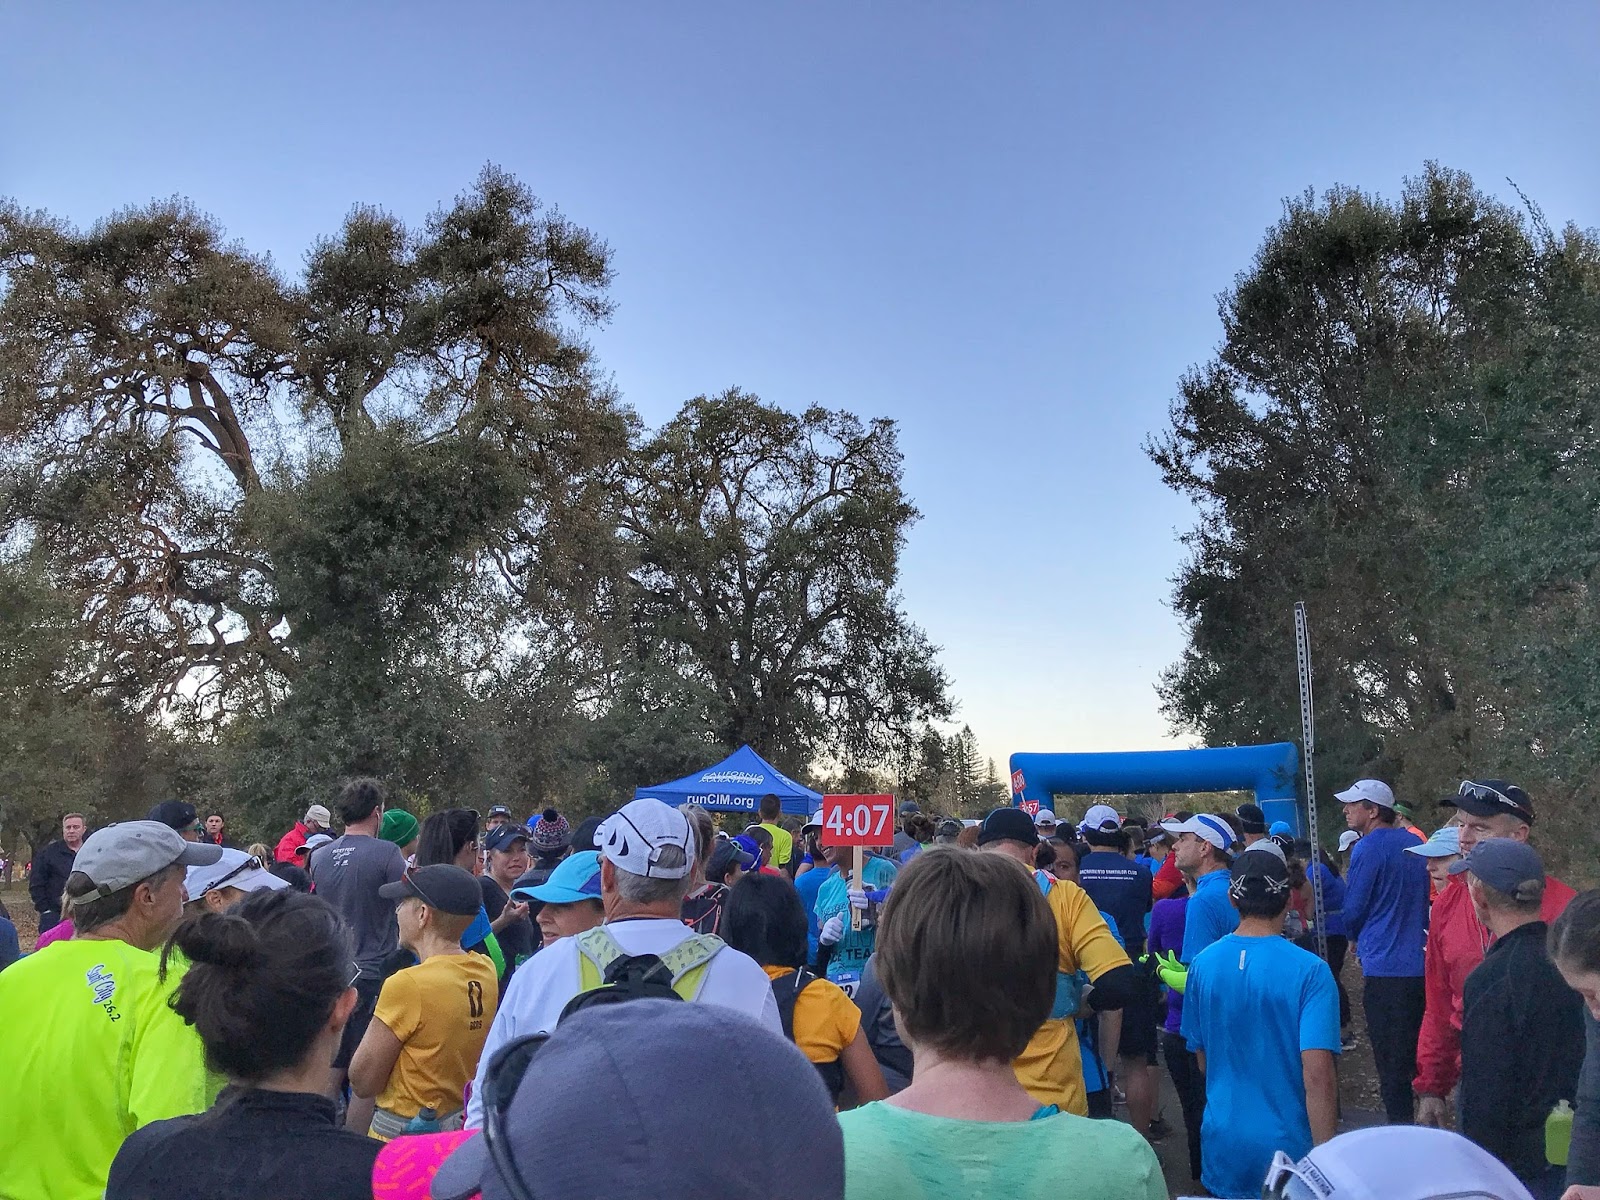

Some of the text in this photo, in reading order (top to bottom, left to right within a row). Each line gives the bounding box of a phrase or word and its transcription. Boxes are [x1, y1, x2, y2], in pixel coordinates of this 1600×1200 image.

[687, 793, 754, 809] runCIM.org
[826, 804, 890, 836] 4:07
[103, 1000, 121, 1023] 26.2
